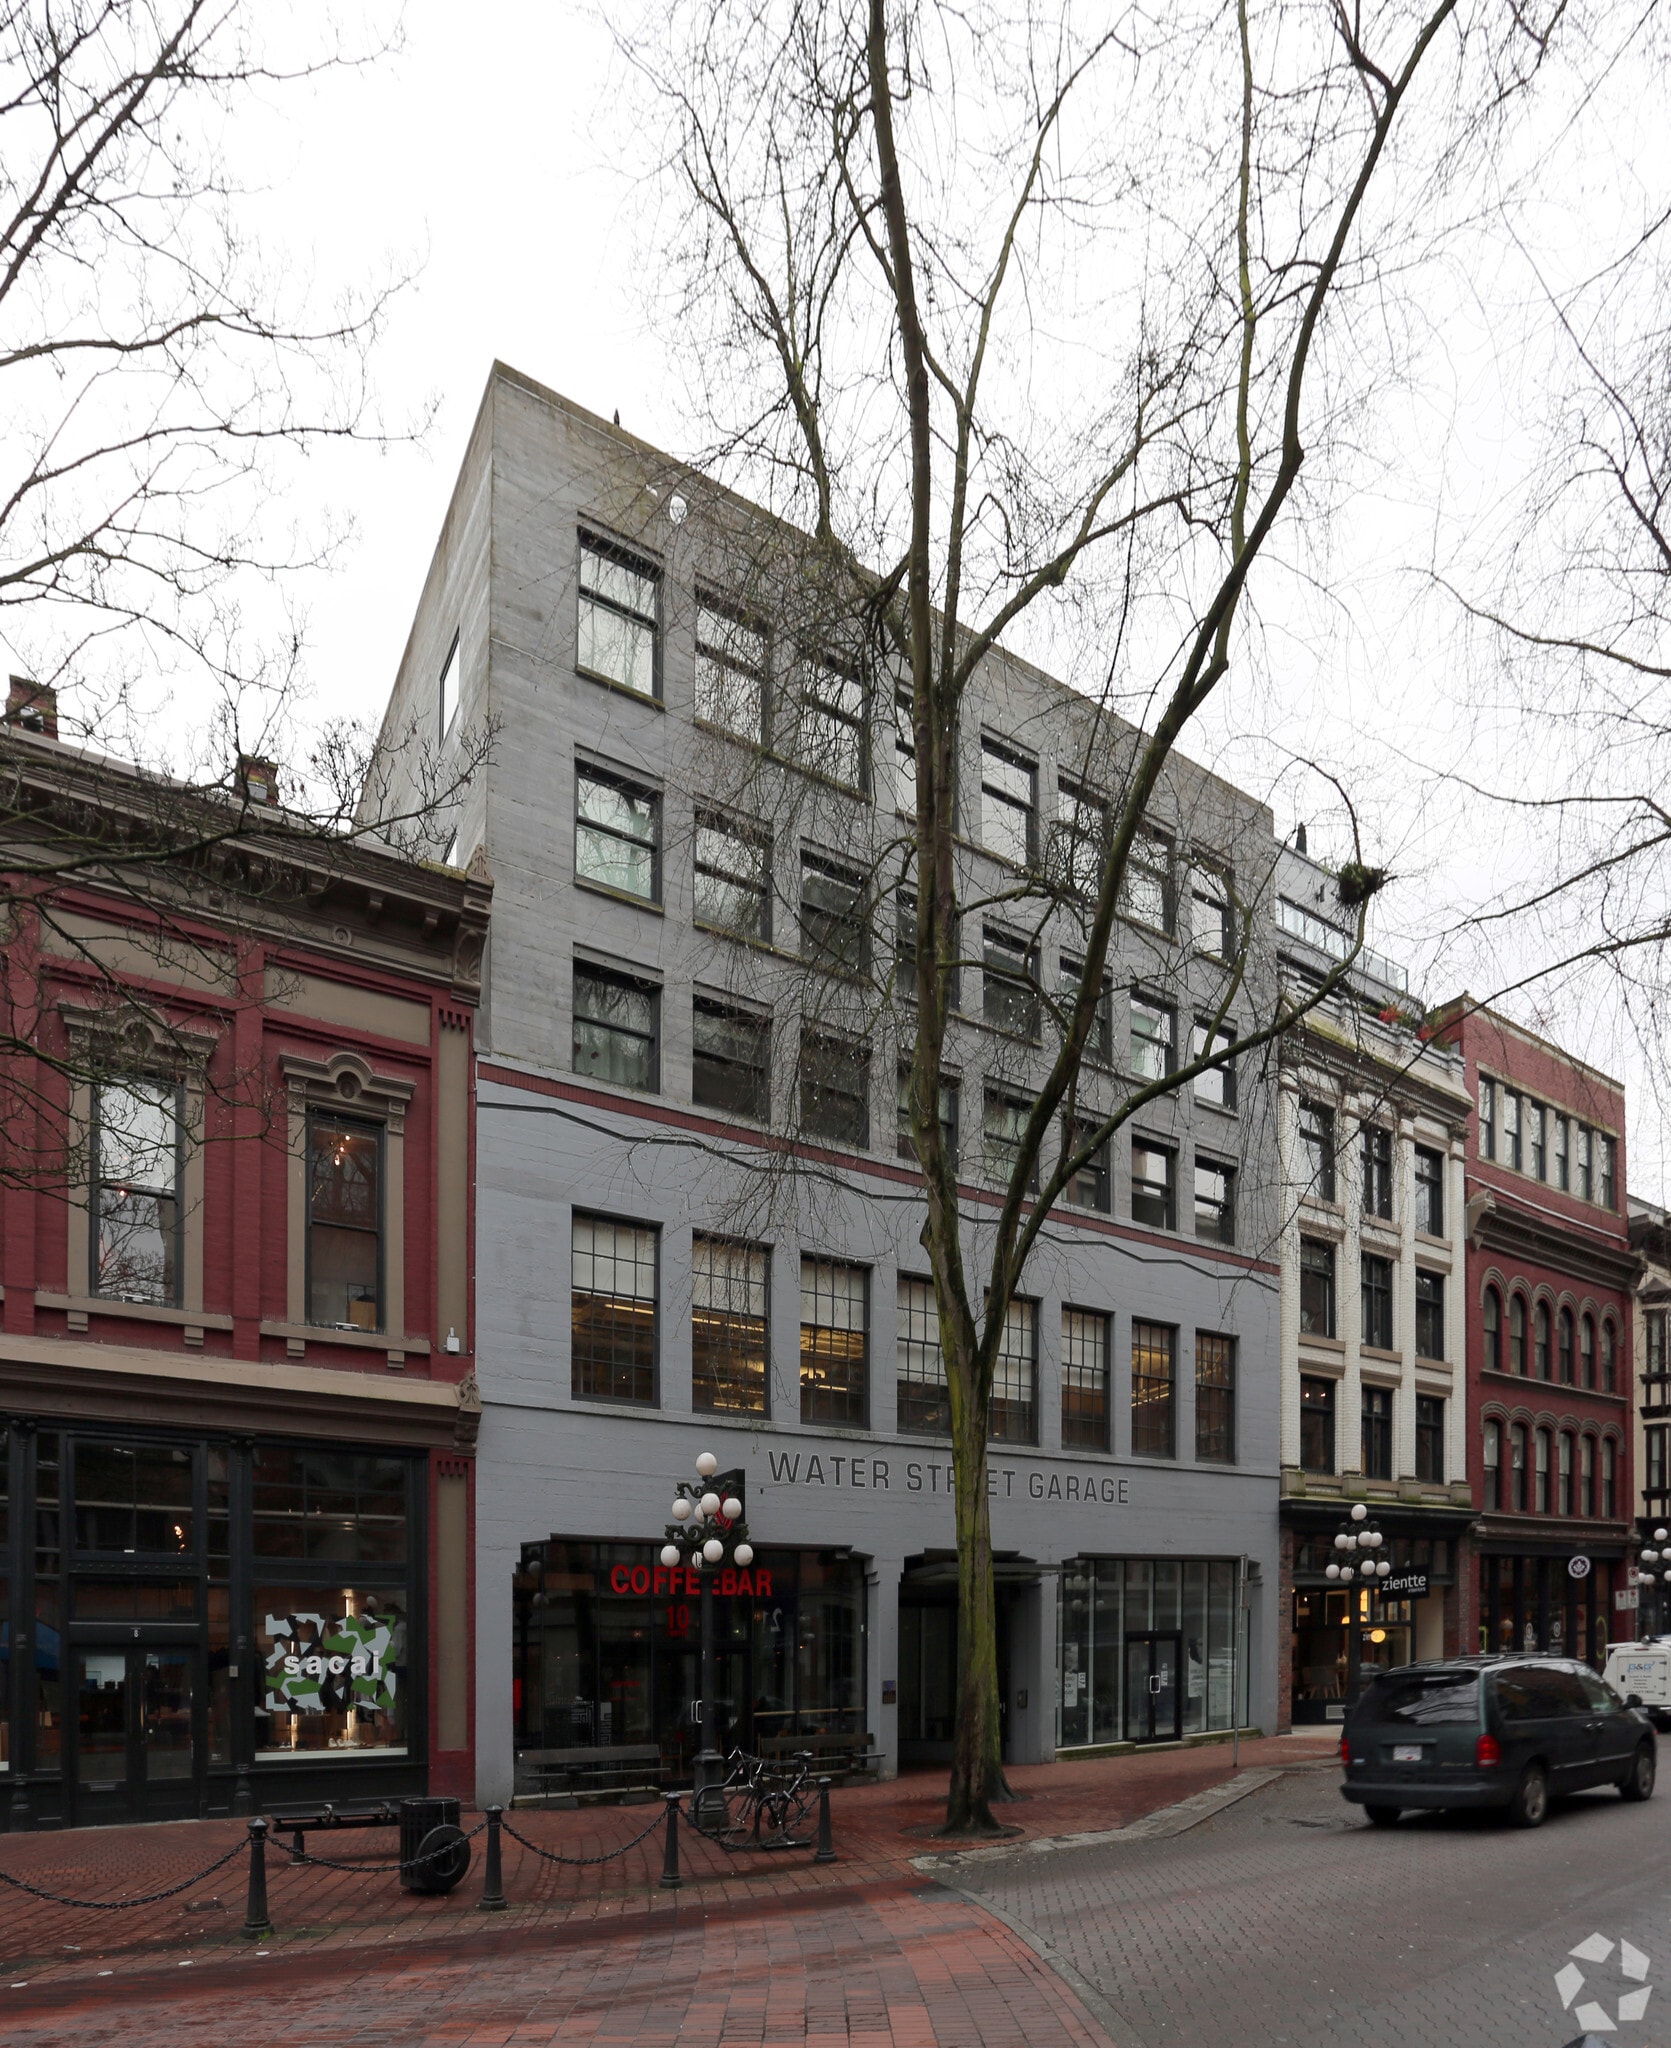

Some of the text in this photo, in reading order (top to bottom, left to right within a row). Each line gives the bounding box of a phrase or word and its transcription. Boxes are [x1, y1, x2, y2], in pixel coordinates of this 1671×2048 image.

[767, 1450, 1130, 1505] WATER STET GARAGE
[610, 1564, 772, 1597] COFFE BAR
[1382, 1574, 1427, 1591] zientte
[665, 1604, 690, 1630] 10
[283, 1650, 380, 1675] sacai
